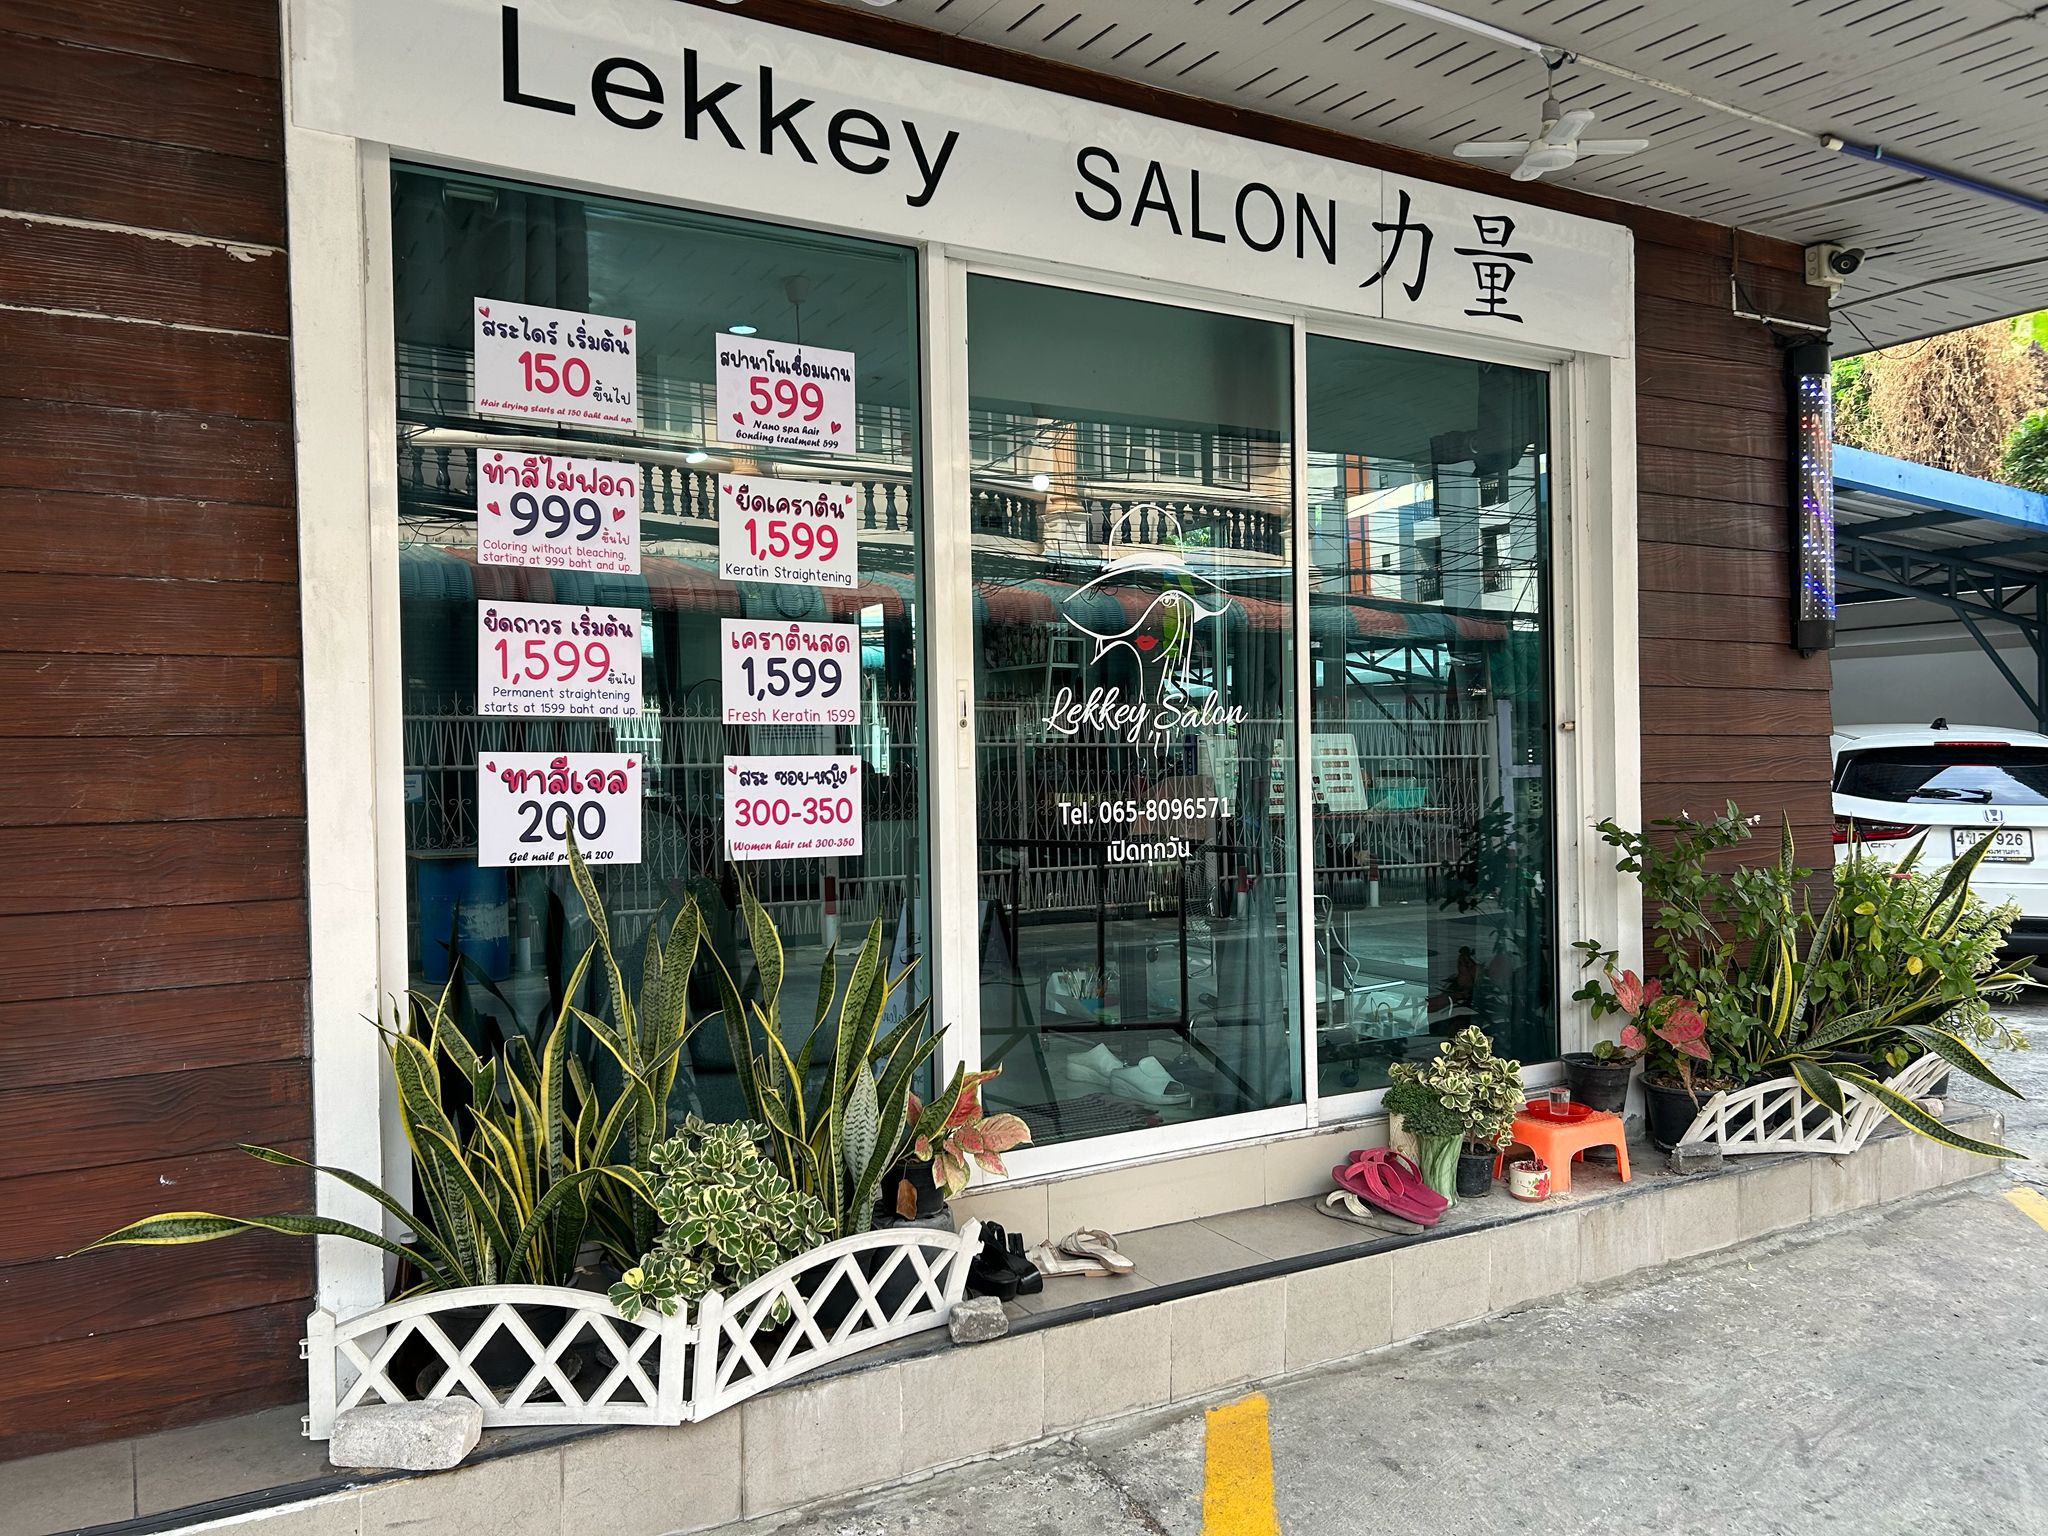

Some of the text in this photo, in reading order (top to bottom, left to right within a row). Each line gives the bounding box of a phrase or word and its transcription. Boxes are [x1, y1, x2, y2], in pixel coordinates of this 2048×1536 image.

[502, 5, 1336, 265] Lekkey SALON
[1359, 189, 1534, 323] 力量
[482, 316, 629, 355] สระไดร์ เริ่มต้น
[518, 351, 591, 397] 150
[720, 348, 850, 382] สปานาโนเชื่อมแกน
[593, 380, 631, 405] ขึ้นไป
[750, 376, 824, 421] 599
[480, 399, 499, 408] Hair
[502, 401, 528, 412] drying
[531, 404, 555, 415] starts
[557, 407, 566, 415] at
[567, 408, 581, 417] 150
[583, 410, 601, 420] baht
[736, 430, 839, 449] bonding treatment 599
[753, 420, 820, 436] Nano spa hair
[482, 453, 635, 498] ทำสีไม่ฟอก
[510, 492, 601, 541] 999
[736, 484, 844, 520] ยืดเคราติน
[483, 540, 528, 554] Coloring
[531, 543, 573, 555] without
[744, 518, 839, 562] 1,599
[483, 553, 633, 573] starting at 999 baht and up.
[726, 563, 851, 585] Keratin Straightening
[484, 607, 633, 638] ยืดถาวร เริ่มต้น
[731, 624, 850, 653] เคราตินสด
[494, 638, 611, 685] 1,599
[608, 669, 635, 685] ขึ้นไป
[742, 657, 842, 701] 1,599
[493, 687, 630, 702] Permanent straightening
[484, 703, 639, 717] starts at 1599 baht and up.
[728, 709, 856, 723] Fresh Keratin 1599
[1042, 686, 1249, 743] Lekkey Salon
[501, 756, 628, 795] ทาสีเจล
[739, 770, 768, 786] สระ
[518, 800, 606, 843] 200
[735, 798, 853, 827] 300-350
[1058, 797, 1231, 825] Tel. 065-8096571
[733, 838, 854, 851] Women hair cut 300-350
[1107, 836, 1191, 867] เปิดทุกวัน
[1996, 833, 2023, 846] 926
[509, 852, 529, 863] Gel
[532, 852, 555, 861] nail
[595, 851, 614, 859] 200
